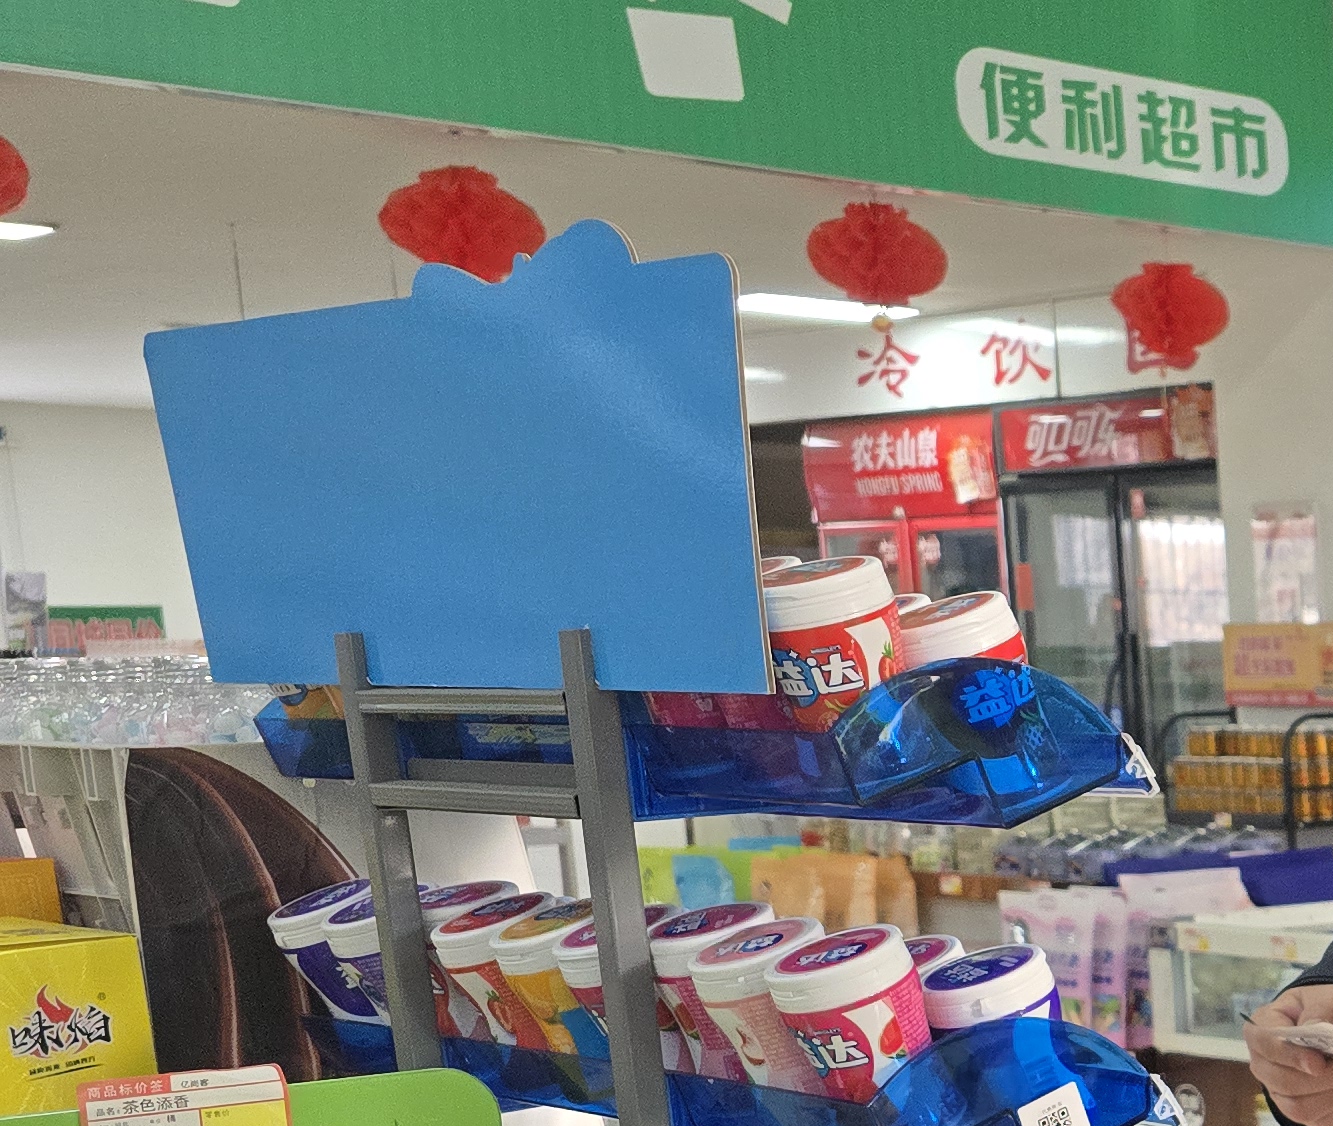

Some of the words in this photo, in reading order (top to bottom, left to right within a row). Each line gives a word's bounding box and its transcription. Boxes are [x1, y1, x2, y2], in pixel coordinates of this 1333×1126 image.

[980, 61, 1269, 181] 便利超市
[851, 427, 939, 472] 农夫山泉
[774, 652, 865, 697] 益达
[87, 1079, 163, 1100] 商品标价签
[181, 1079, 209, 1089] 亿尚客
[122, 1094, 190, 1115] 茶色添香
